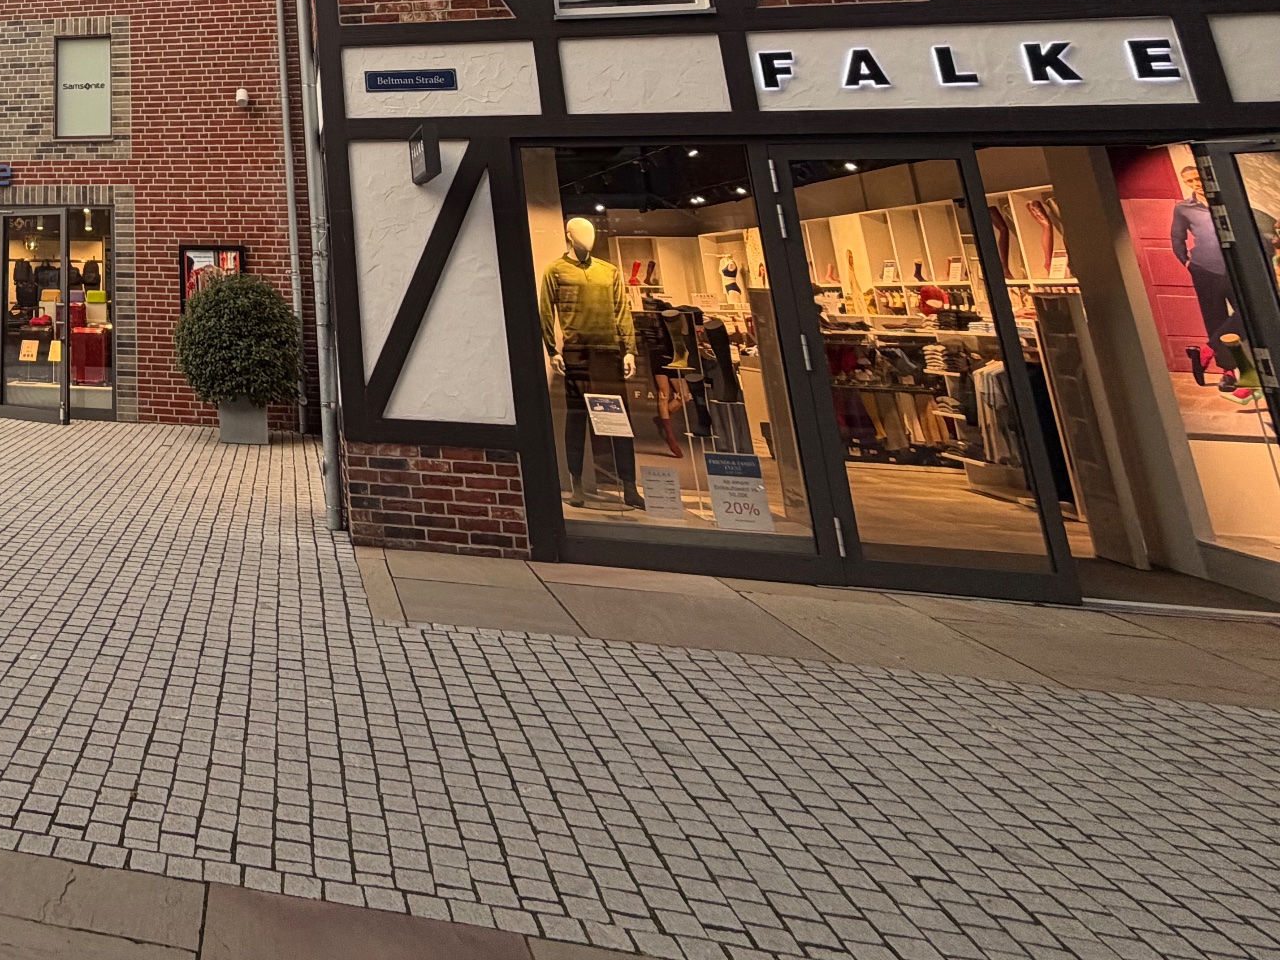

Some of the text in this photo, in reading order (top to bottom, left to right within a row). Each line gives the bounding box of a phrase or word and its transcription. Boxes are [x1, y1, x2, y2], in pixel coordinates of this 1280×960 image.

[757, 38, 1182, 90] FALKE
[62, 82, 106, 90] Samsonite
[377, 75, 445, 85] Beltman Straße
[723, 501, 761, 516] 20%
